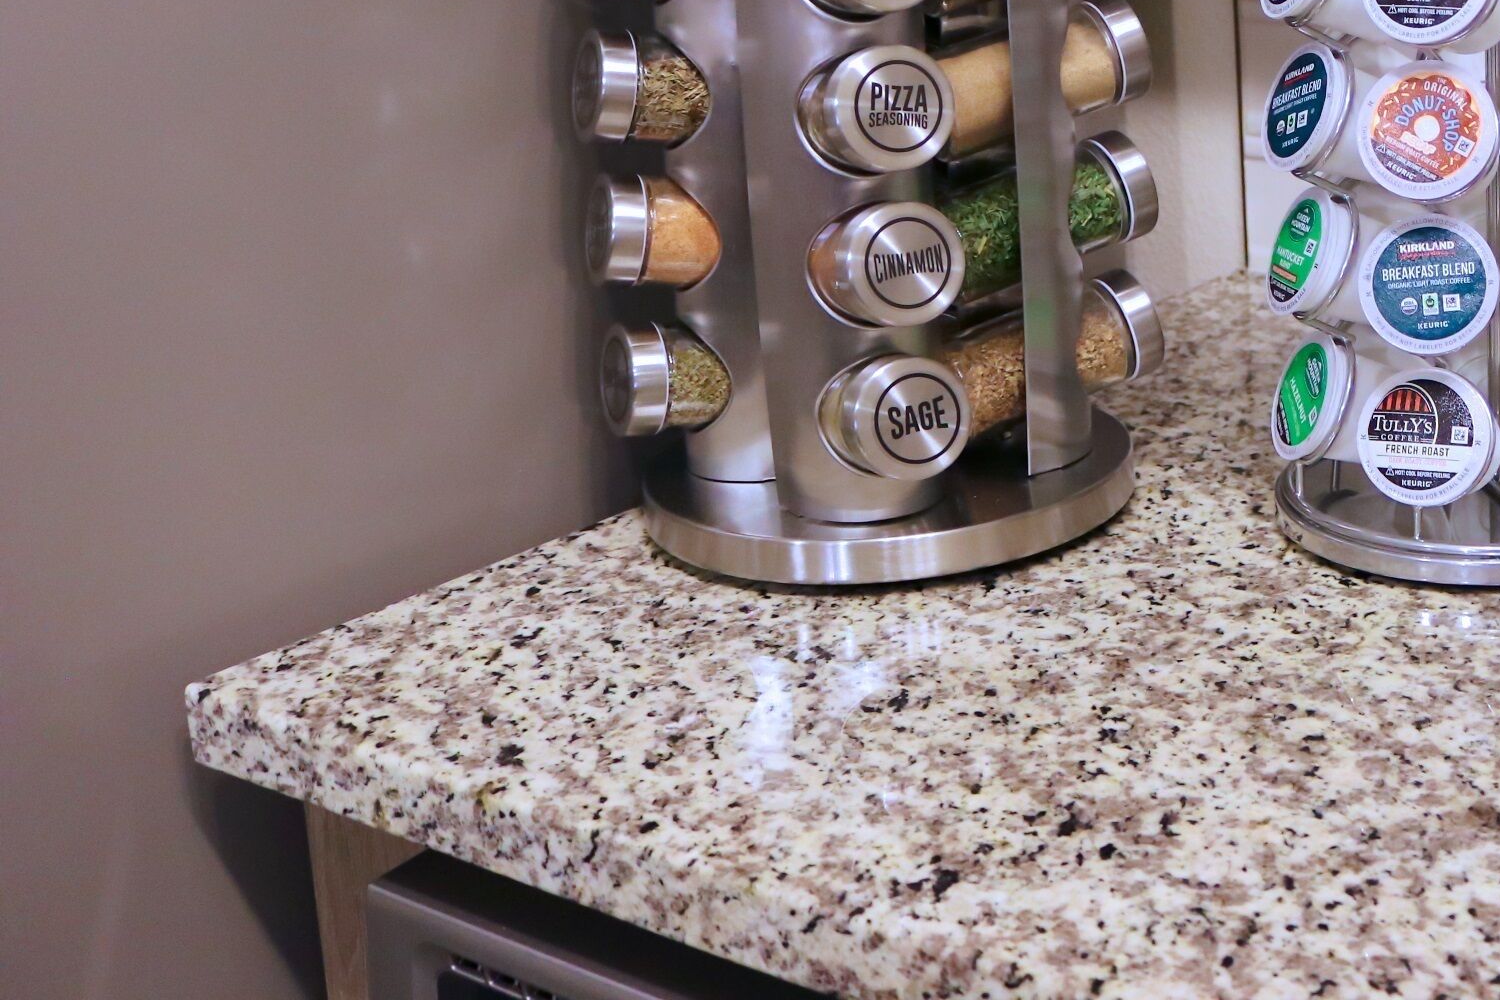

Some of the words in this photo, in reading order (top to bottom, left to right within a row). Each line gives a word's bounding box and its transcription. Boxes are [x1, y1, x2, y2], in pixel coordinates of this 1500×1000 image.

[1403, 17, 1433, 25] KEURIG
[1284, 63, 1314, 81] KIRKLAND
[870, 82, 928, 113] PIZZA
[1272, 85, 1302, 109] BREAKFAST
[1301, 79, 1322, 97] BLEND
[1424, 81, 1468, 112] ORIGINAL
[868, 112, 928, 130] SEASONING
[1395, 95, 1445, 127] DONUT
[1442, 108, 1461, 152] SHOP
[1386, 161, 1414, 180] KEURIG
[1399, 241, 1455, 253] KIRKLAND
[873, 243, 944, 284] CINNAMON
[1381, 263, 1440, 282] BREAKFAST
[1442, 261, 1475, 276] BLEND
[1449, 276, 1471, 285] COFFEE
[1417, 320, 1449, 330] KEURIG
[1289, 376, 1307, 423] HAZELNUT
[887, 394, 949, 440] SAGE
[1380, 433, 1420, 442] COFFEE
[1385, 443, 1418, 455] FRENCH
[1421, 446, 1450, 457] ROAST
[1401, 479, 1431, 488] KEURIG
